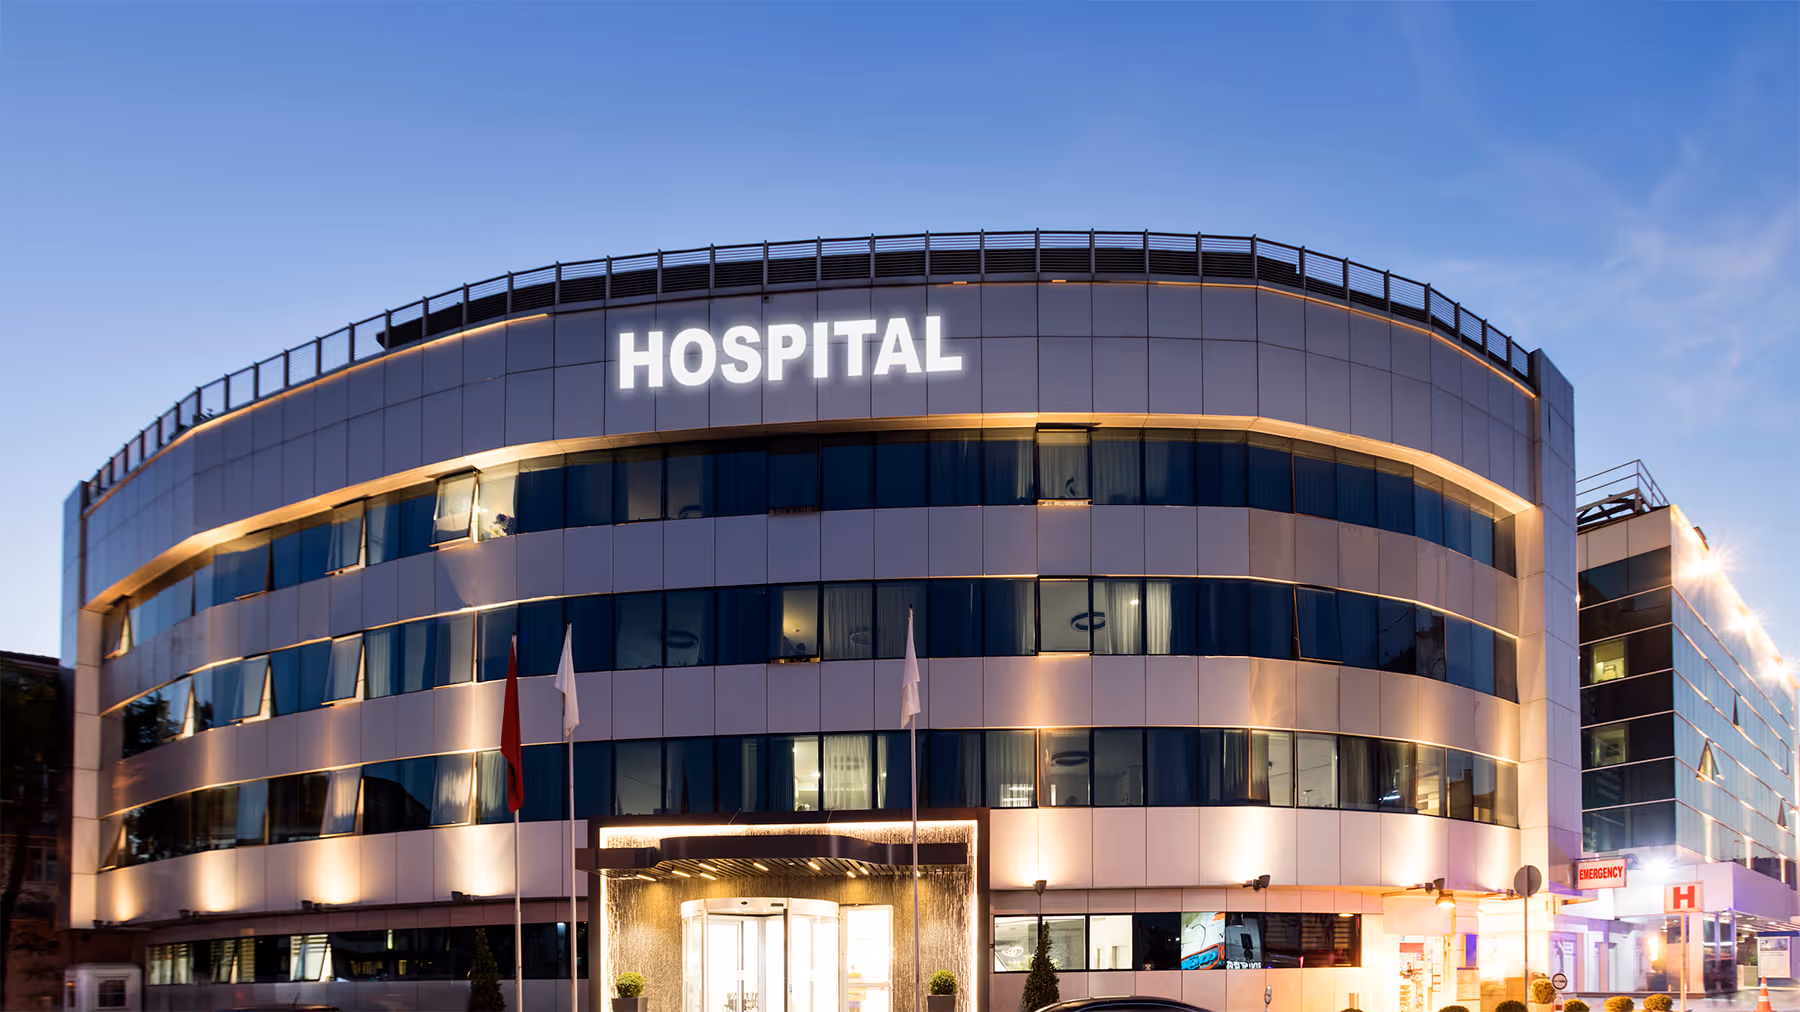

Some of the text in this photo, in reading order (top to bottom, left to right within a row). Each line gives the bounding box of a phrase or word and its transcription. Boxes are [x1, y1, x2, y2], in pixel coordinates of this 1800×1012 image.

[619, 315, 963, 389] HOSPITAL
[1579, 865, 1623, 880] EMERGENCY
[1673, 885, 1695, 910] H
